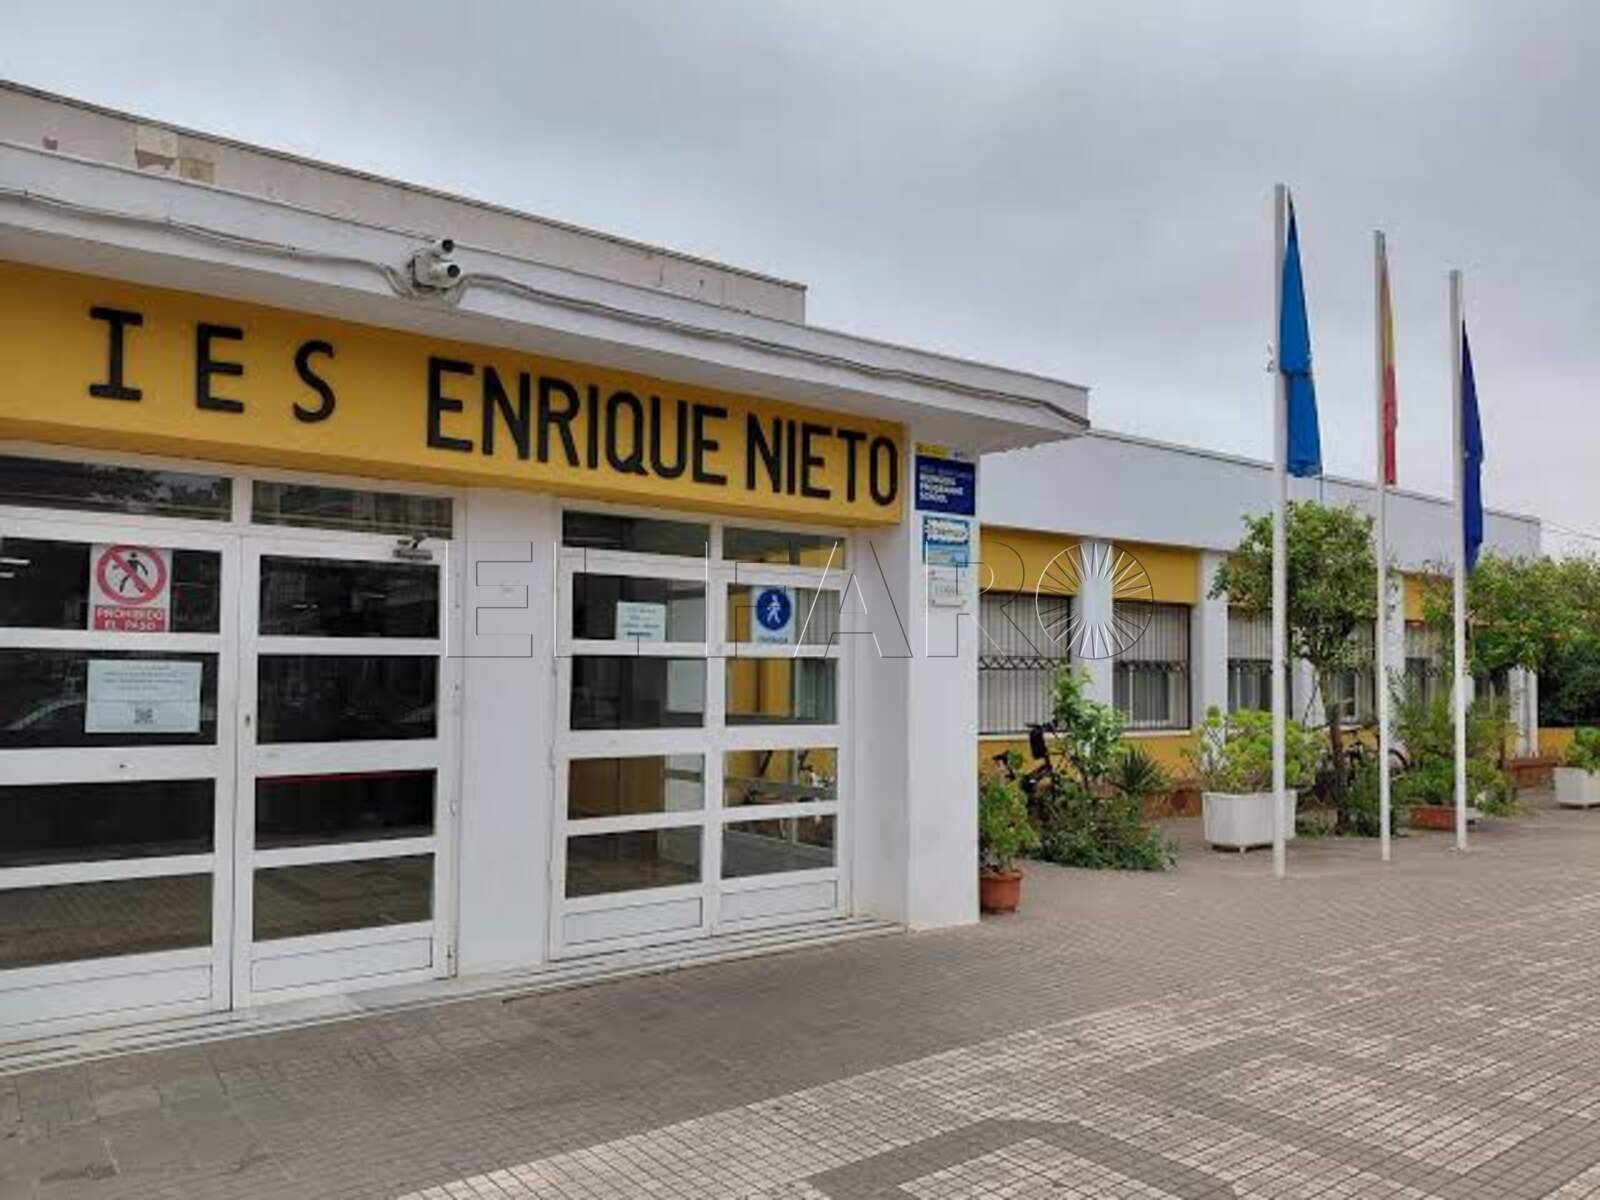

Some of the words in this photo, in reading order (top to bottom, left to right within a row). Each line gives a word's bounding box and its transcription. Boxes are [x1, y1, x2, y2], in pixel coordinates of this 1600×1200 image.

[426, 356, 728, 484] ENRIQUE
[745, 412, 899, 506] NIETO
[124, 619, 156, 631] PASO
